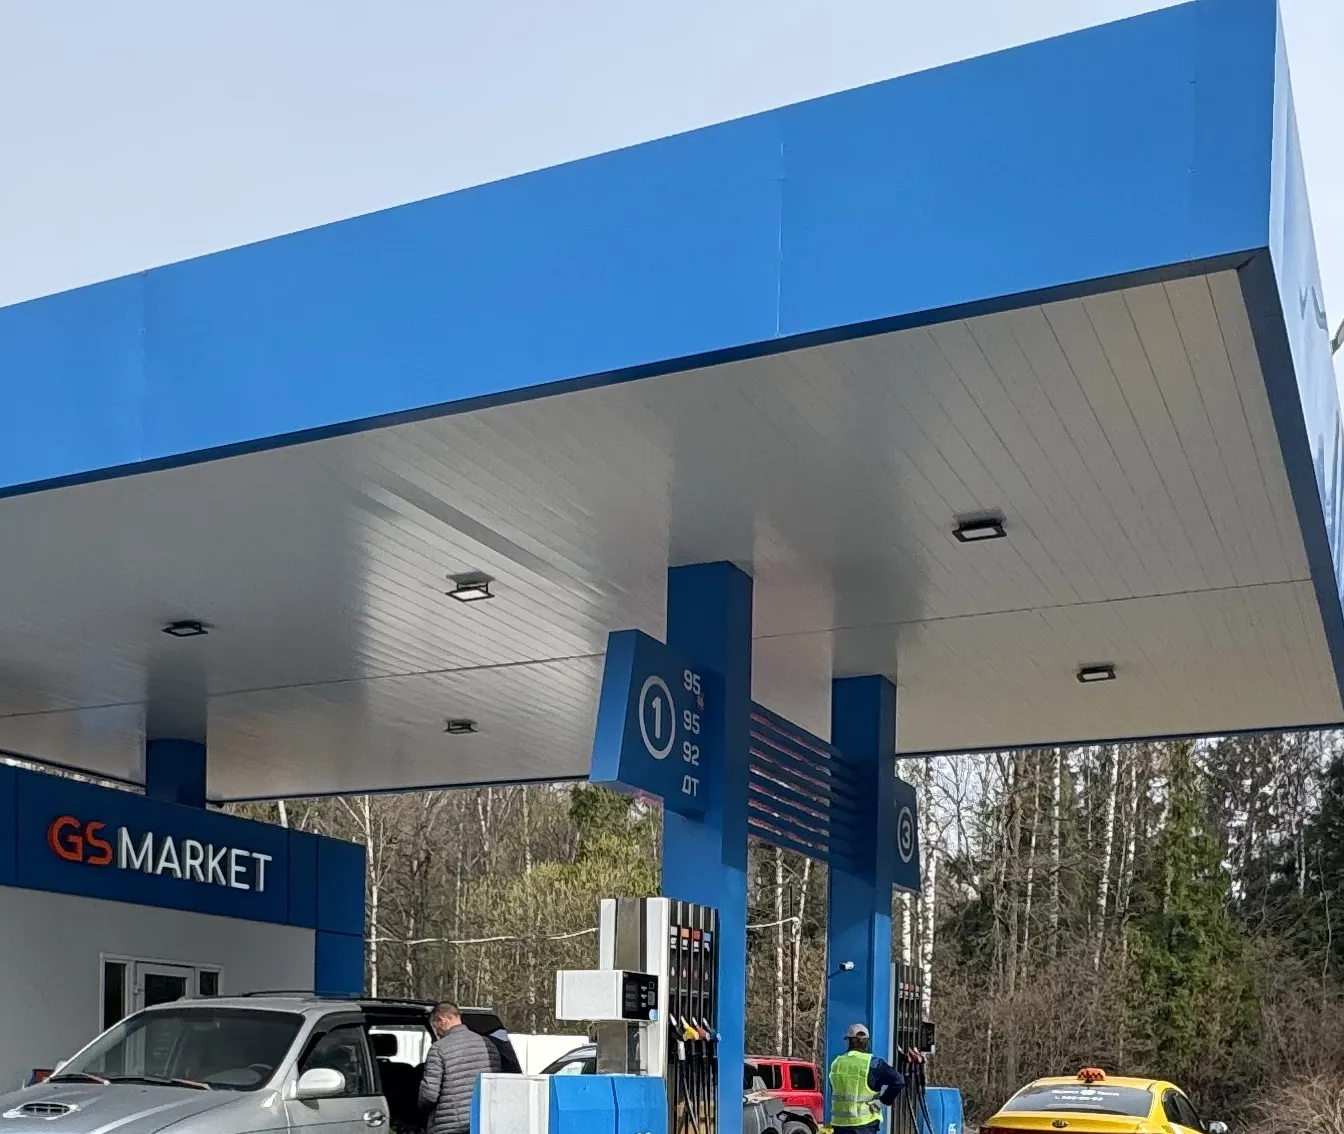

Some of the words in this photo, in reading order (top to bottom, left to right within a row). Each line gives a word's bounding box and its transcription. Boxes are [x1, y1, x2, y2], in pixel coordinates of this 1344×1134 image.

[683, 669, 701, 696] 95
[651, 696, 662, 739] 1
[683, 709, 701, 735] 95
[682, 740, 700, 767] 92
[681, 774, 700, 797] ДТ
[901, 820, 911, 849] 3
